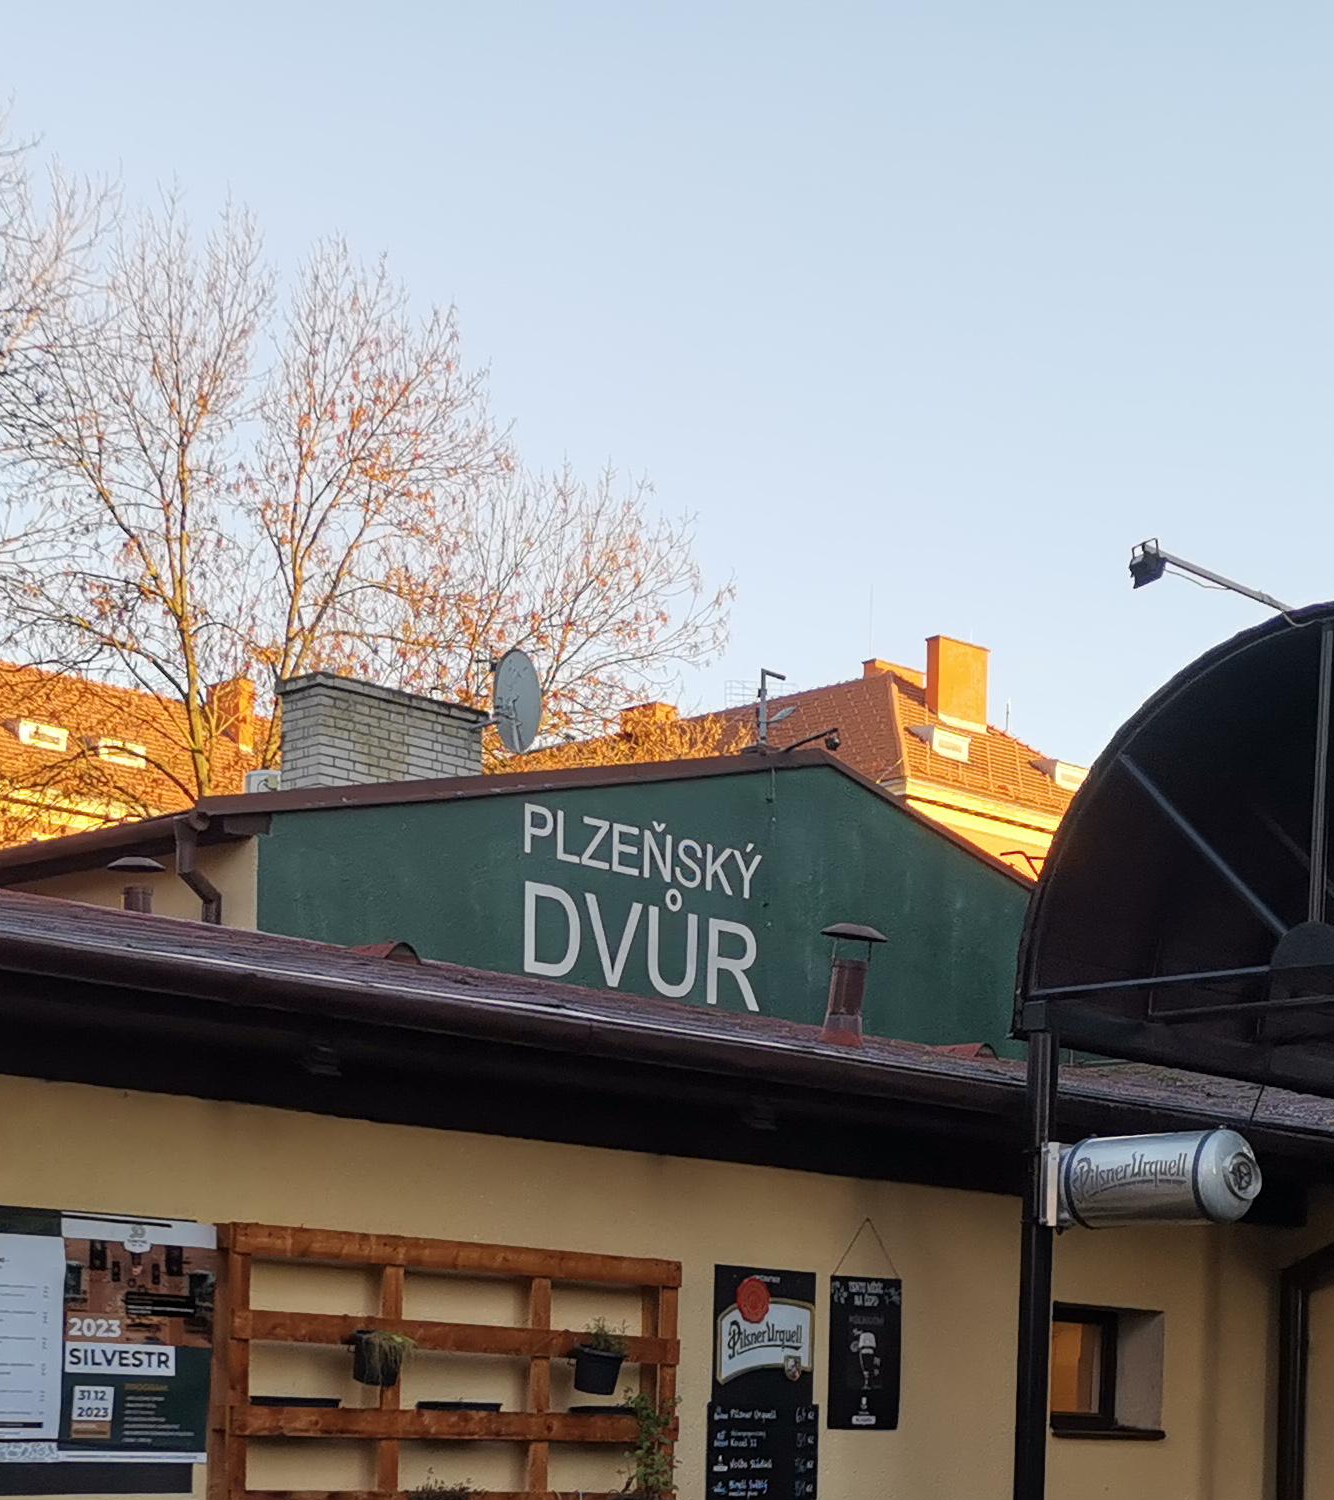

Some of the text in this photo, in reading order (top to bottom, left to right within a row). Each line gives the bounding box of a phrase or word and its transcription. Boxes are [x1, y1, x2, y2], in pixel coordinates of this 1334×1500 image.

[523, 802, 763, 900] PLZEŇSKÝ
[523, 880, 760, 1013] DVŮR
[1072, 1156, 1131, 1204] Pilsner
[1129, 1151, 1188, 1188] Urquell
[68, 1317, 122, 1338] 2023
[727, 1319, 803, 1360] Pilsner Urquell
[68, 1348, 170, 1369] SILVESTR
[77, 1407, 109, 1418] 2023
